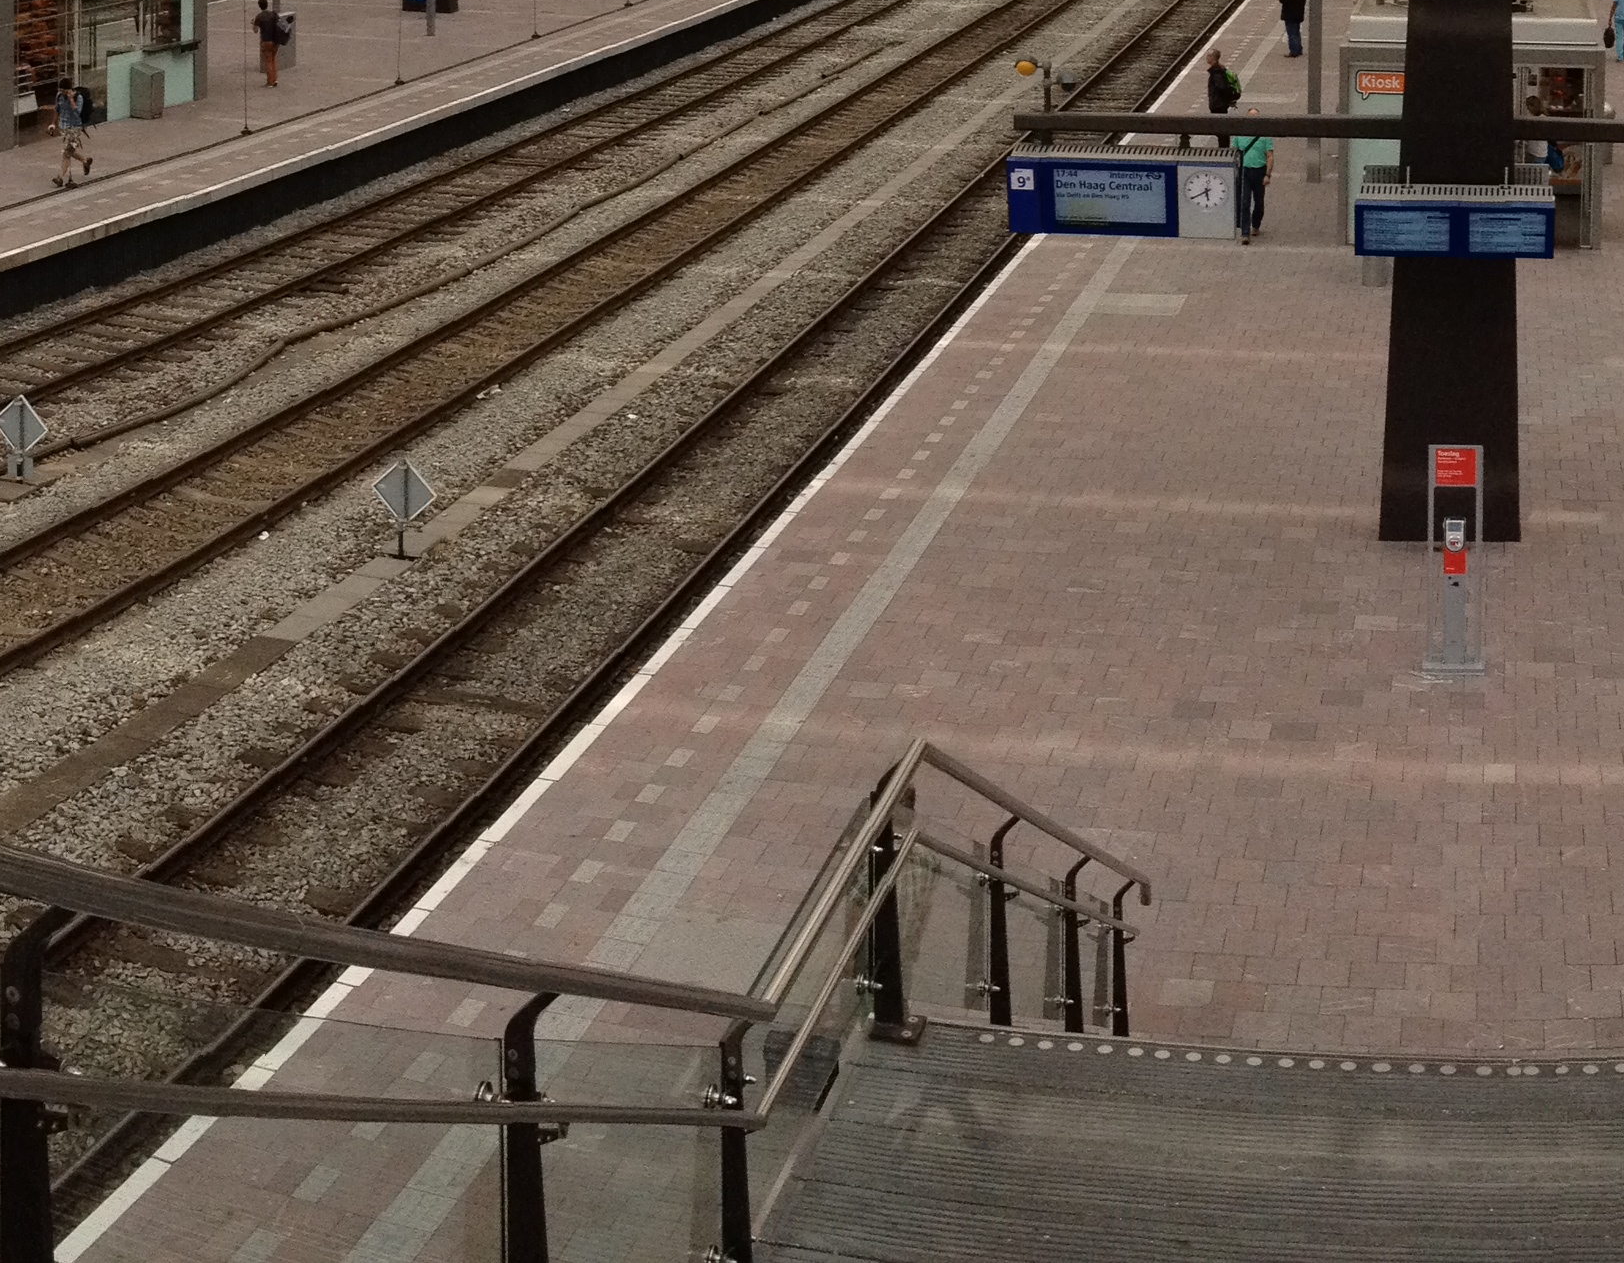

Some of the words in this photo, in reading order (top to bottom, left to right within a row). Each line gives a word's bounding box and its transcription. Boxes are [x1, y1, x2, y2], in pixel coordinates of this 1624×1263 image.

[1361, 75, 1401, 88] Kiosk
[1056, 169, 1078, 179] 17:44
[1109, 172, 1143, 181] Intercity
[1055, 180, 1076, 189] Den
[1079, 181, 1106, 192] Haag
[1109, 182, 1153, 192] Centraal
